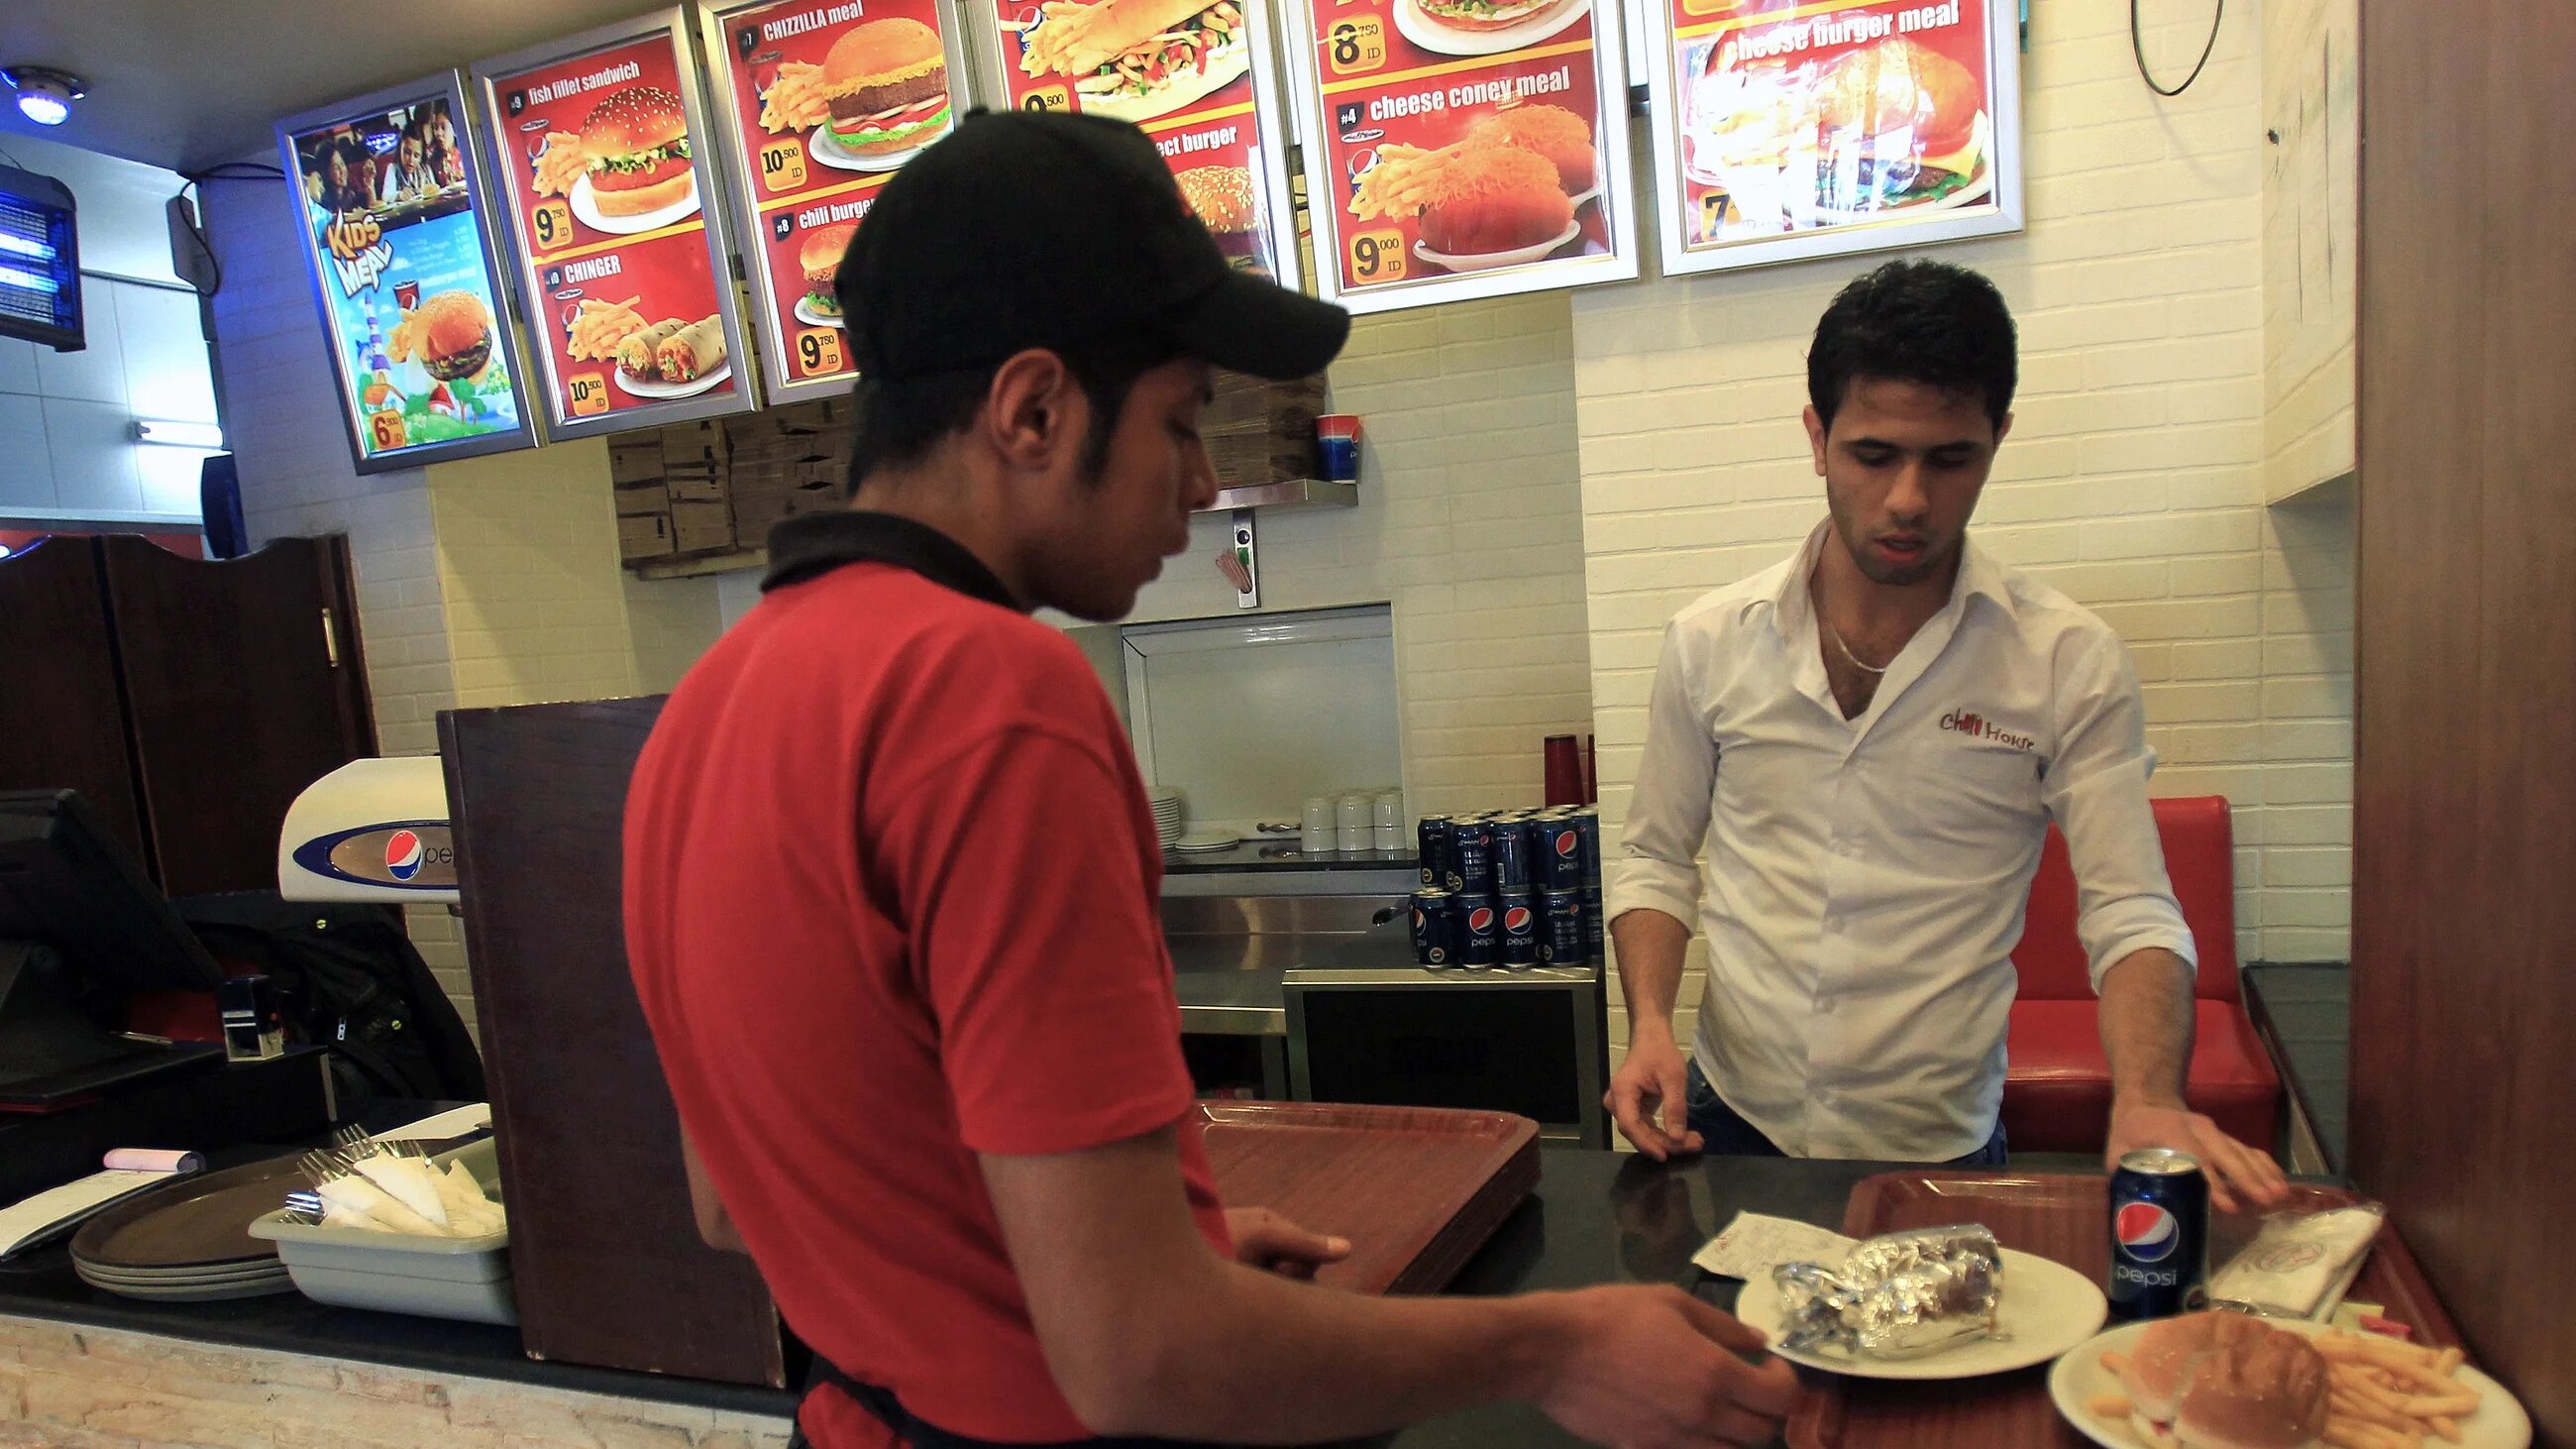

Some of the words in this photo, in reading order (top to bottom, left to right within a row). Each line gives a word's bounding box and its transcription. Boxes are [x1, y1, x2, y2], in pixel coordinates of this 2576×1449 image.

[763, 9, 827, 42] CHIZZILLA
[827, 0, 864, 24] meal
[1810, 12, 1893, 47] burger
[1897, 0, 1959, 34] meal
[528, 83, 553, 105] fish
[552, 76, 582, 99] fillet
[581, 60, 641, 91] sandwich
[1341, 108, 1356, 125] #4
[1369, 89, 1445, 121] cheese
[1449, 78, 1514, 108] coney
[1516, 65, 1569, 97] meal
[1155, 136, 1181, 158] ect
[1182, 126, 1237, 150] burger
[327, 208, 382, 259] KIDS
[777, 219, 790, 234] #8
[799, 206, 830, 229] chili
[333, 240, 393, 298] MEAL
[564, 255, 621, 284] CHINGER
[1387, 260, 1402, 273] ID
[424, 846, 455, 868] pe
[1506, 936, 1535, 947] pepsi
[2116, 1265, 2178, 1288] pepsi
